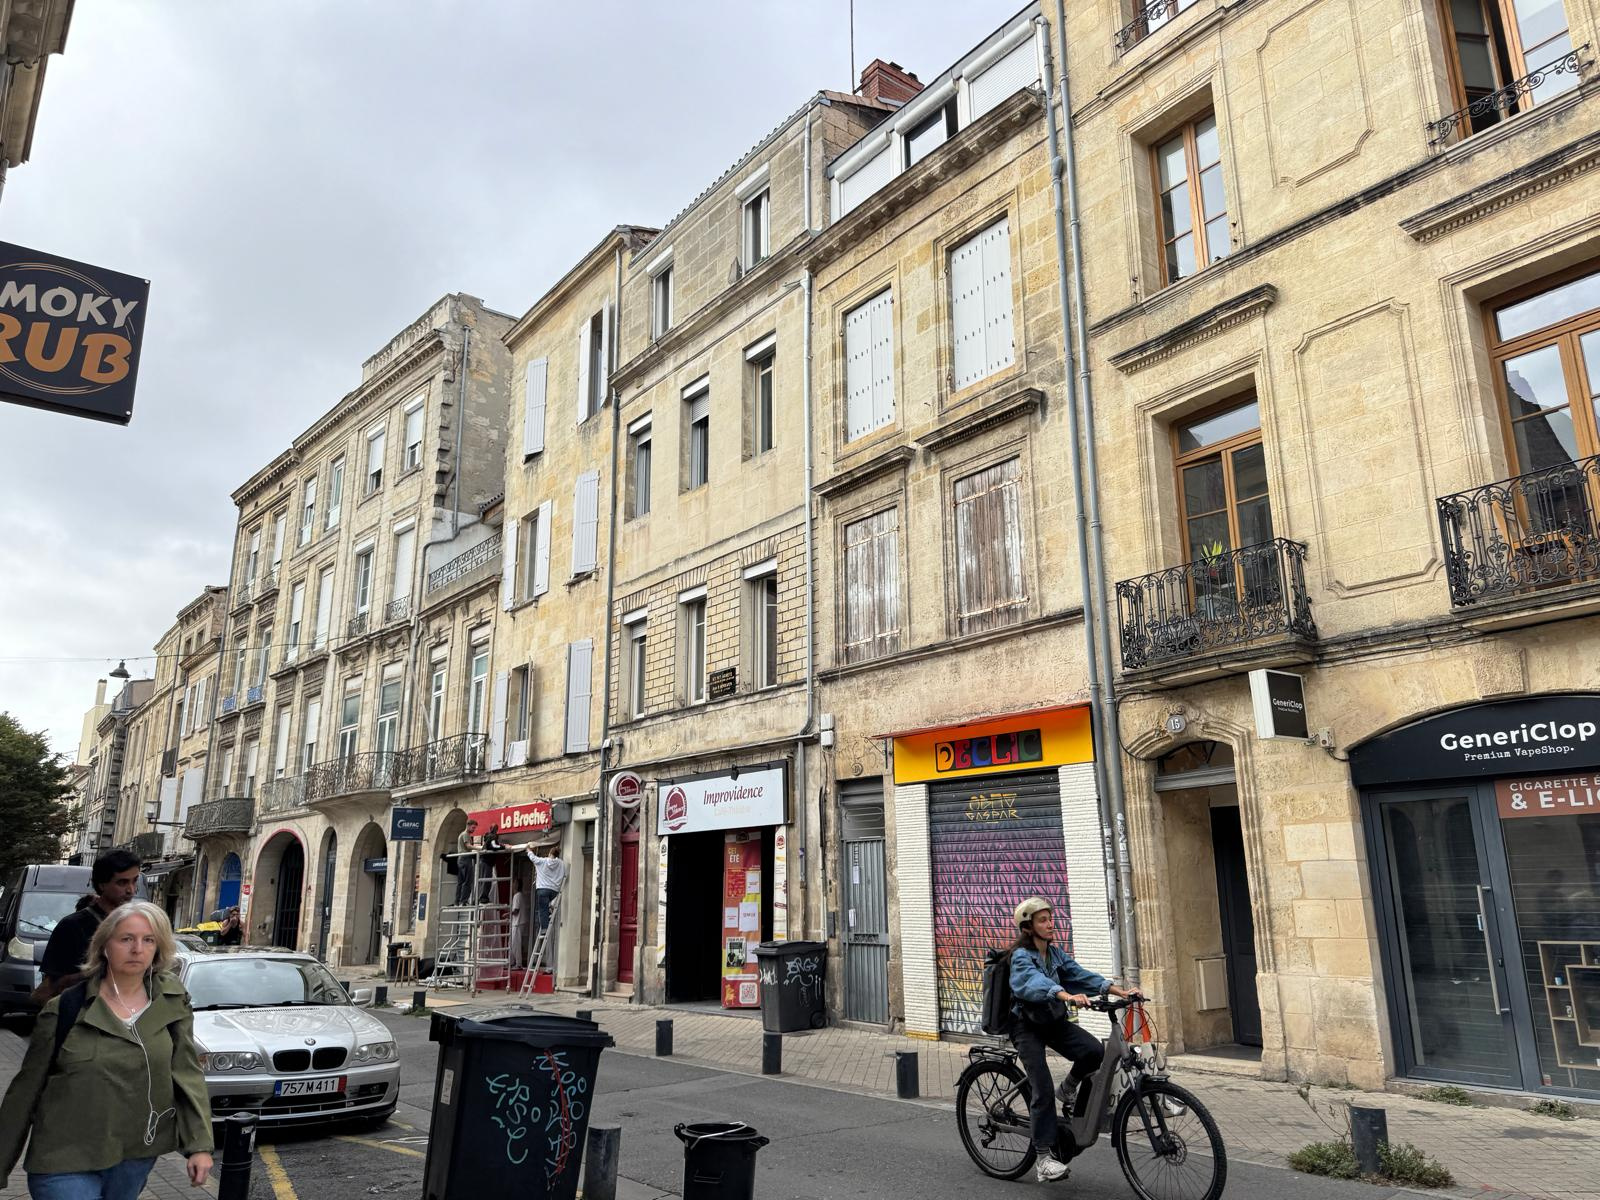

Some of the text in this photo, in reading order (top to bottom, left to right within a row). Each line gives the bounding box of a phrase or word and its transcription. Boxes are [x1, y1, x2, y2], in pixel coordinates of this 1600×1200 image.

[1272, 698, 1303, 711] GeneriClop
[1440, 721, 1597, 752] GeneriClop
[936, 732, 1040, 771] DECLIC
[1464, 750, 1511, 762] Premium
[1509, 777, 1588, 792] CIGARETTE
[703, 785, 764, 807] Improvidence
[1511, 787, 1600, 810] & E-LI
[965, 809, 1020, 821] GASPAR
